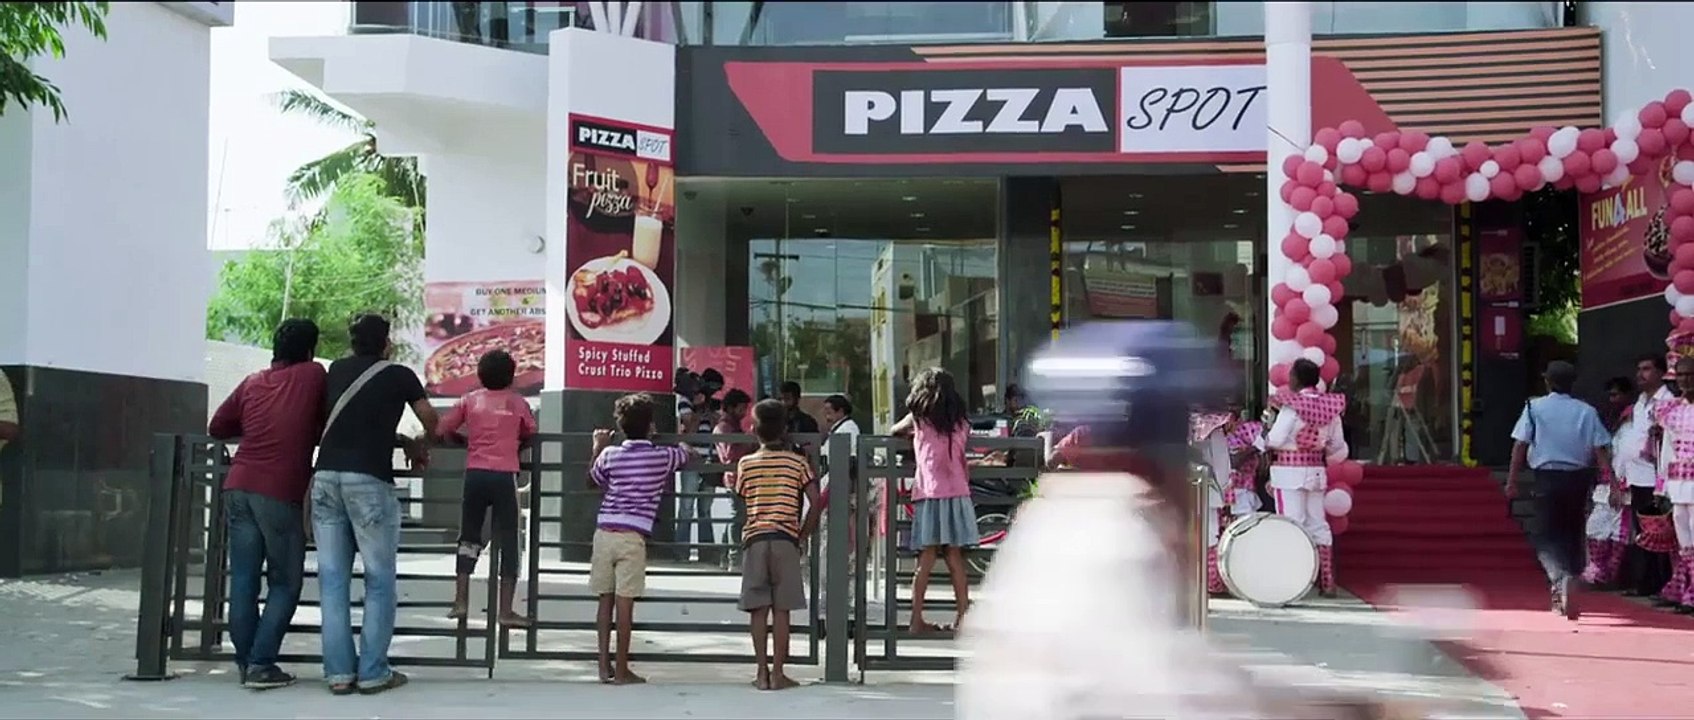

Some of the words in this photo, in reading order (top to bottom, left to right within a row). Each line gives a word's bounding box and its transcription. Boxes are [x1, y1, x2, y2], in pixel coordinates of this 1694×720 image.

[844, 87, 1110, 136] PIZZA
[1126, 85, 1268, 131] SPOT
[578, 126, 636, 151] PIZZA
[639, 136, 668, 153] SPOT
[572, 162, 620, 192] Fruit
[585, 191, 633, 219] pizza
[475, 288, 492, 296] BUY
[494, 287, 512, 296] ONE
[470, 308, 487, 316] GET
[488, 307, 527, 316] ANOTHER
[578, 346, 608, 363] Spicy
[611, 348, 651, 363] Stuffed
[578, 362, 606, 376] Crust
[610, 364, 631, 377] Trio
[635, 366, 663, 379] Pizza
